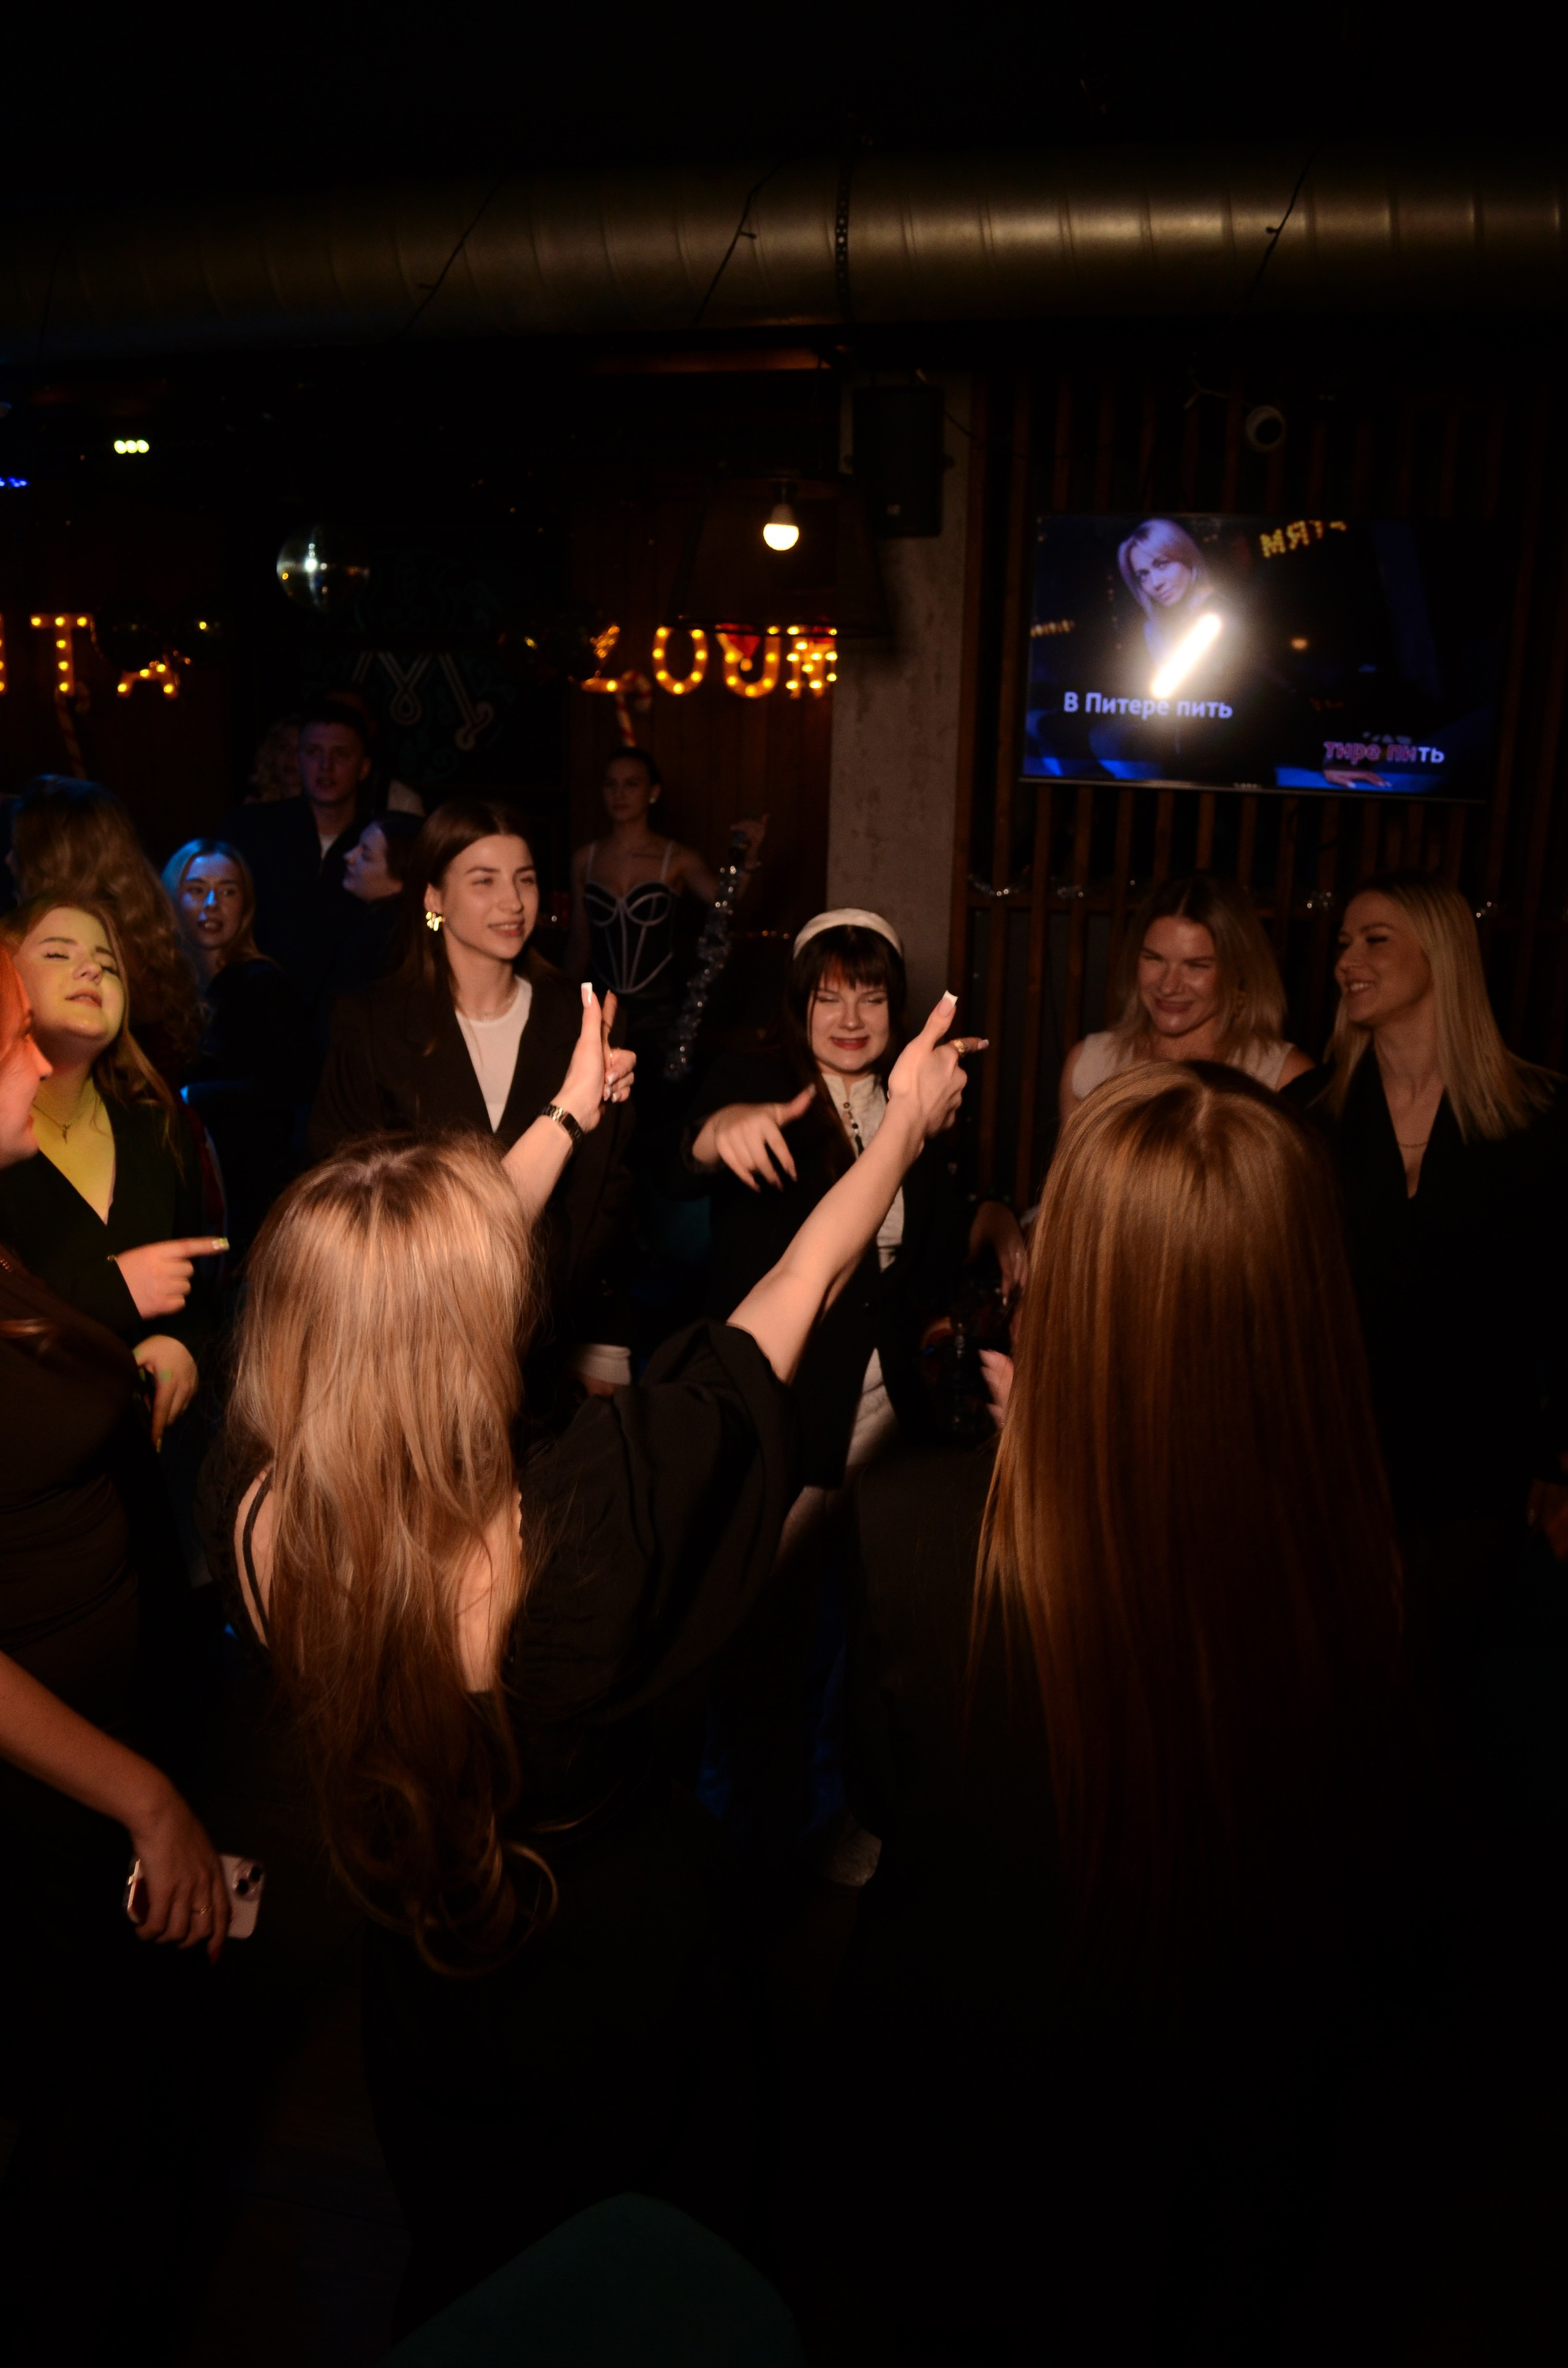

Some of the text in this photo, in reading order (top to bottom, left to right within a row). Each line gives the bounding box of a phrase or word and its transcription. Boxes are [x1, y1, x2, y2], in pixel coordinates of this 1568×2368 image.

[1063, 690, 1234, 721] В Питере пить
[1323, 740, 1445, 766] тире пить
